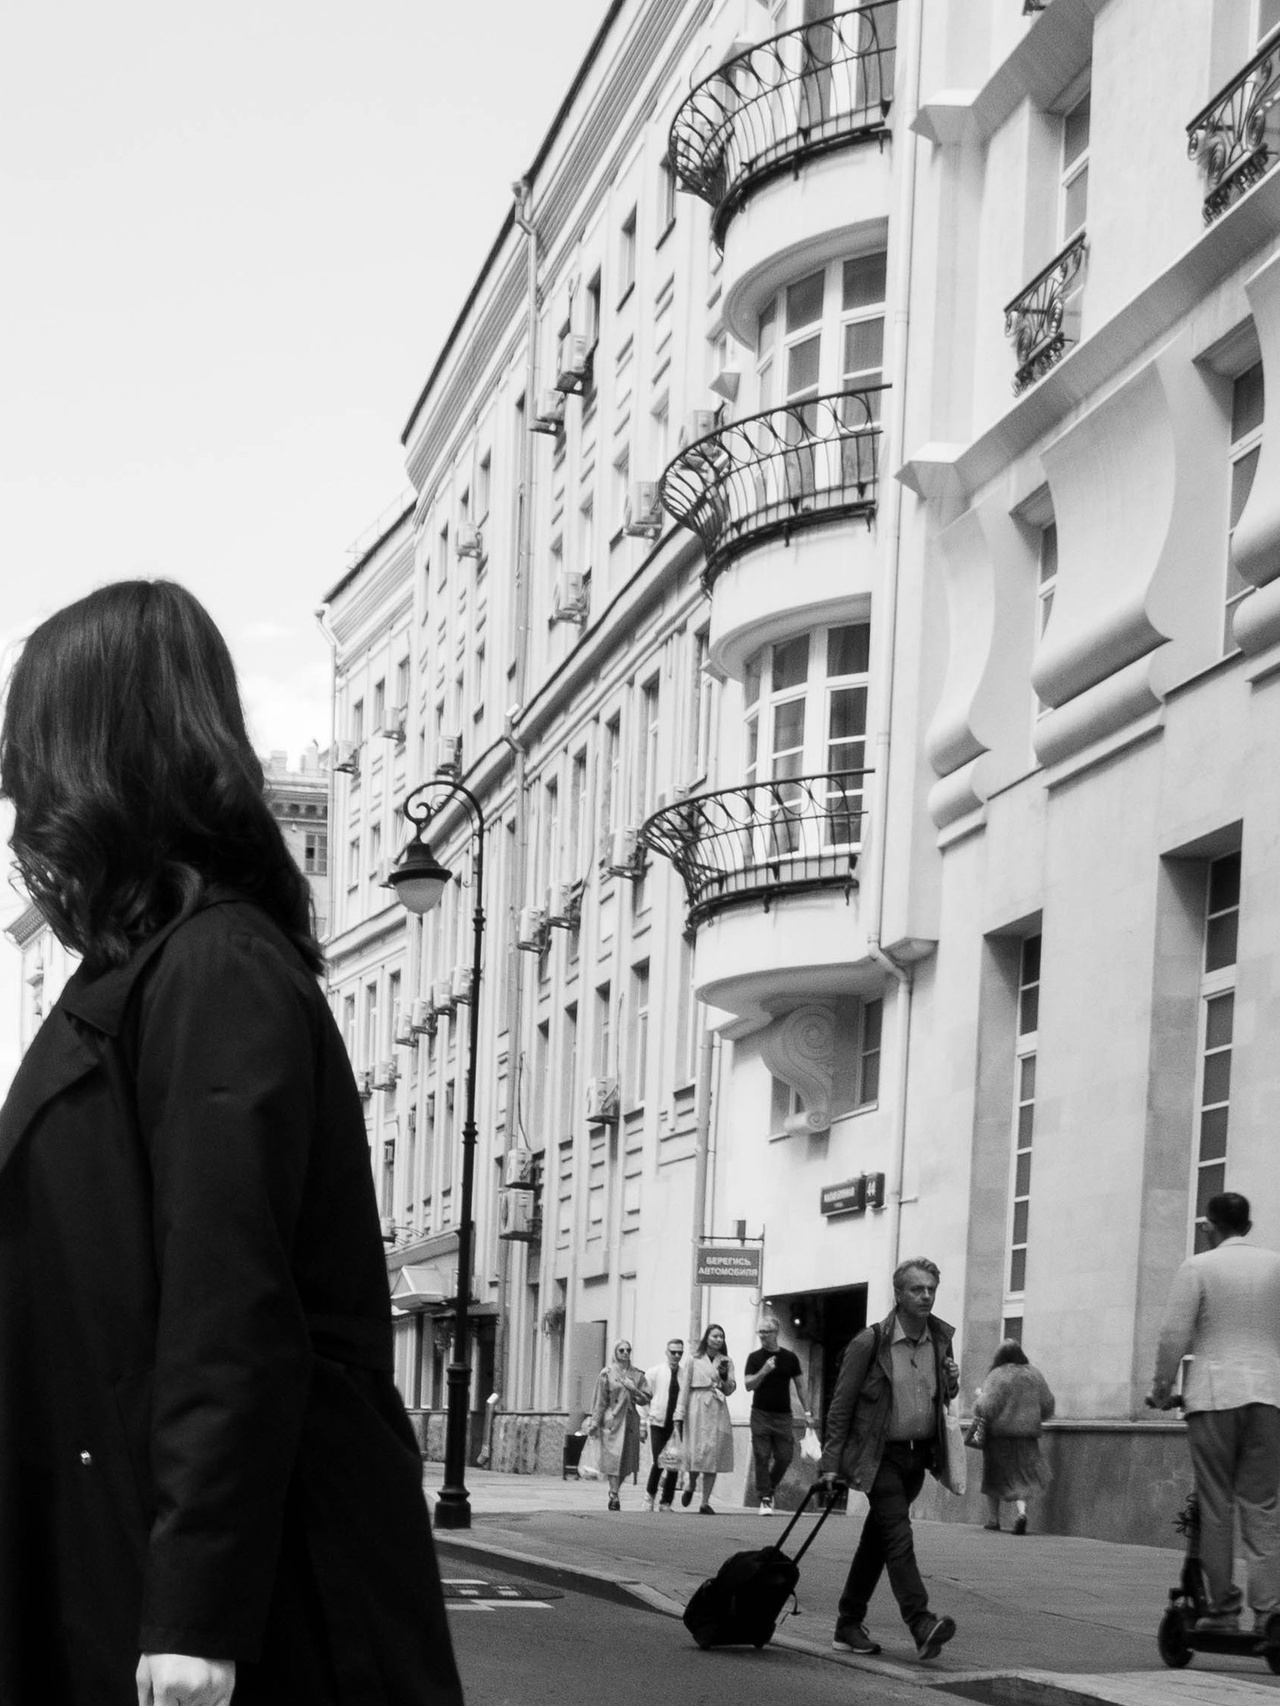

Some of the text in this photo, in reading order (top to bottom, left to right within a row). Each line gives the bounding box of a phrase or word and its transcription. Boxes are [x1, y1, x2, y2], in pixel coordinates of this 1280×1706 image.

[867, 1180, 877, 1197] 44
[705, 1256, 752, 1266] БЕРЕГИСЬ
[697, 1266, 758, 1277] АВТОМОБИЛЯ
